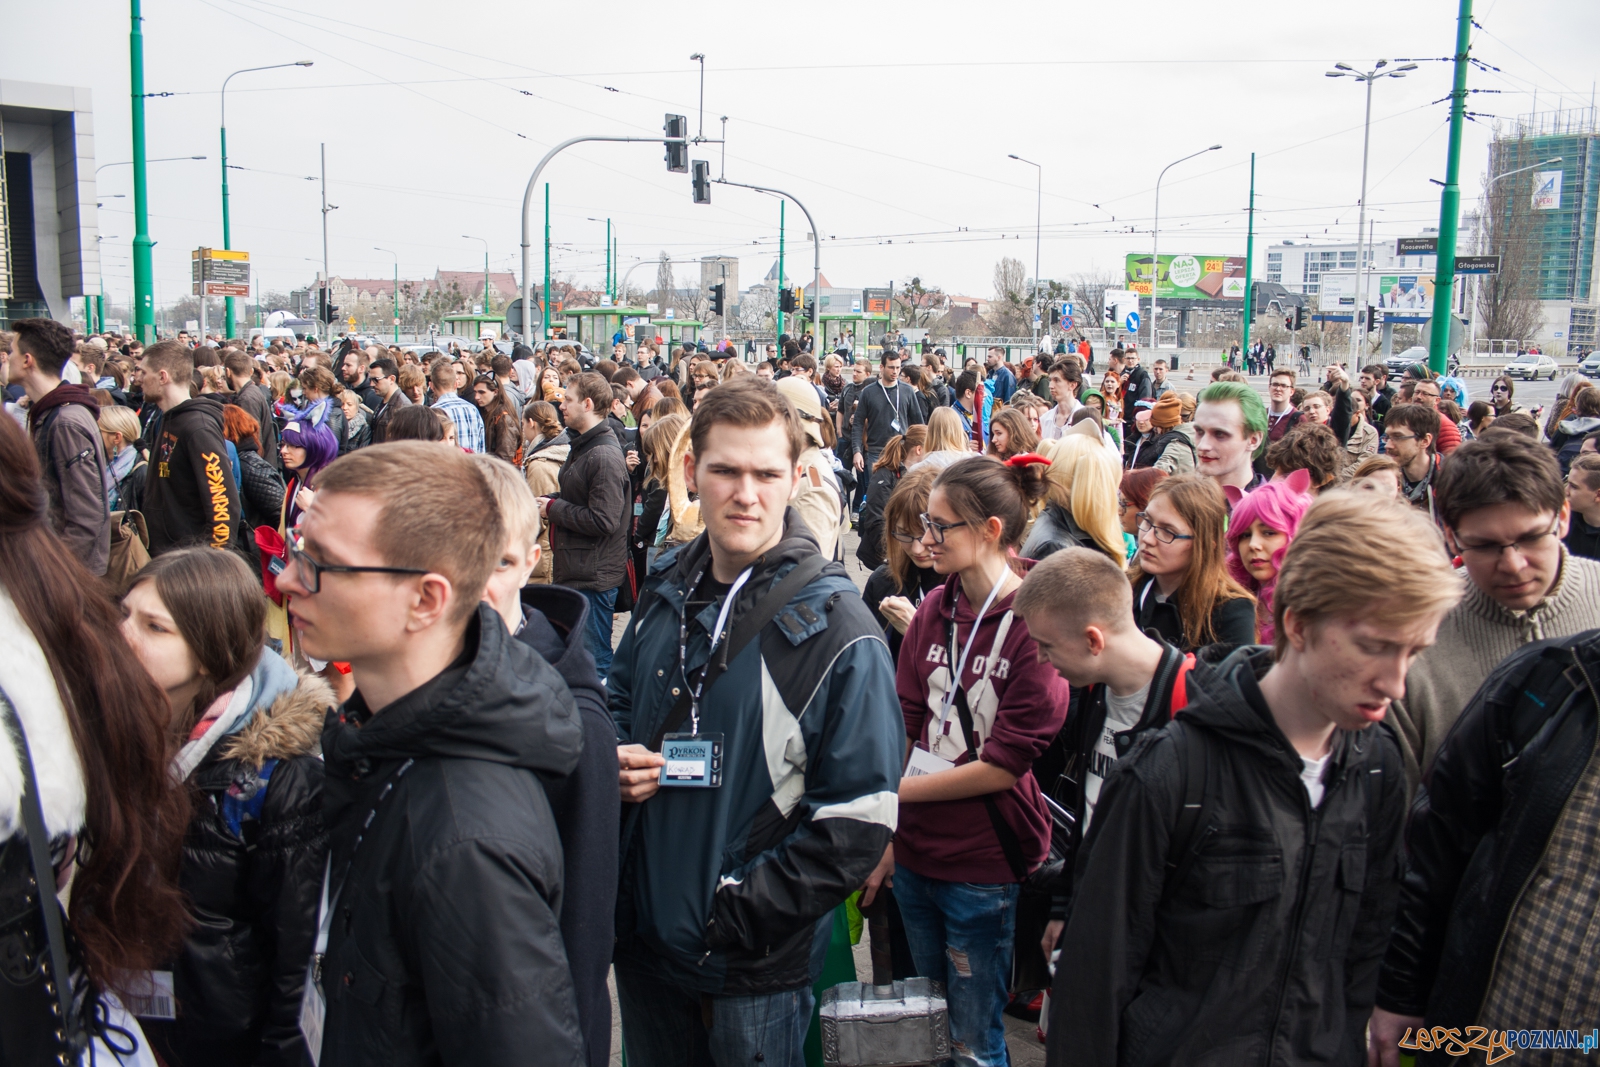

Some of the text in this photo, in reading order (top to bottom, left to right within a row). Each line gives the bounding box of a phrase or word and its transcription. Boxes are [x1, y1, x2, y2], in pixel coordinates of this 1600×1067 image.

[1173, 258, 1195, 269] NAJ
[1206, 262, 1216, 271] 24
[1457, 261, 1495, 271] Głogowska
[1174, 267, 1195, 275] LEPSZA
[1174, 272, 1197, 280] OFERTA
[201, 451, 231, 521] DRINKERS
[668, 746, 706, 759] PYRKON
